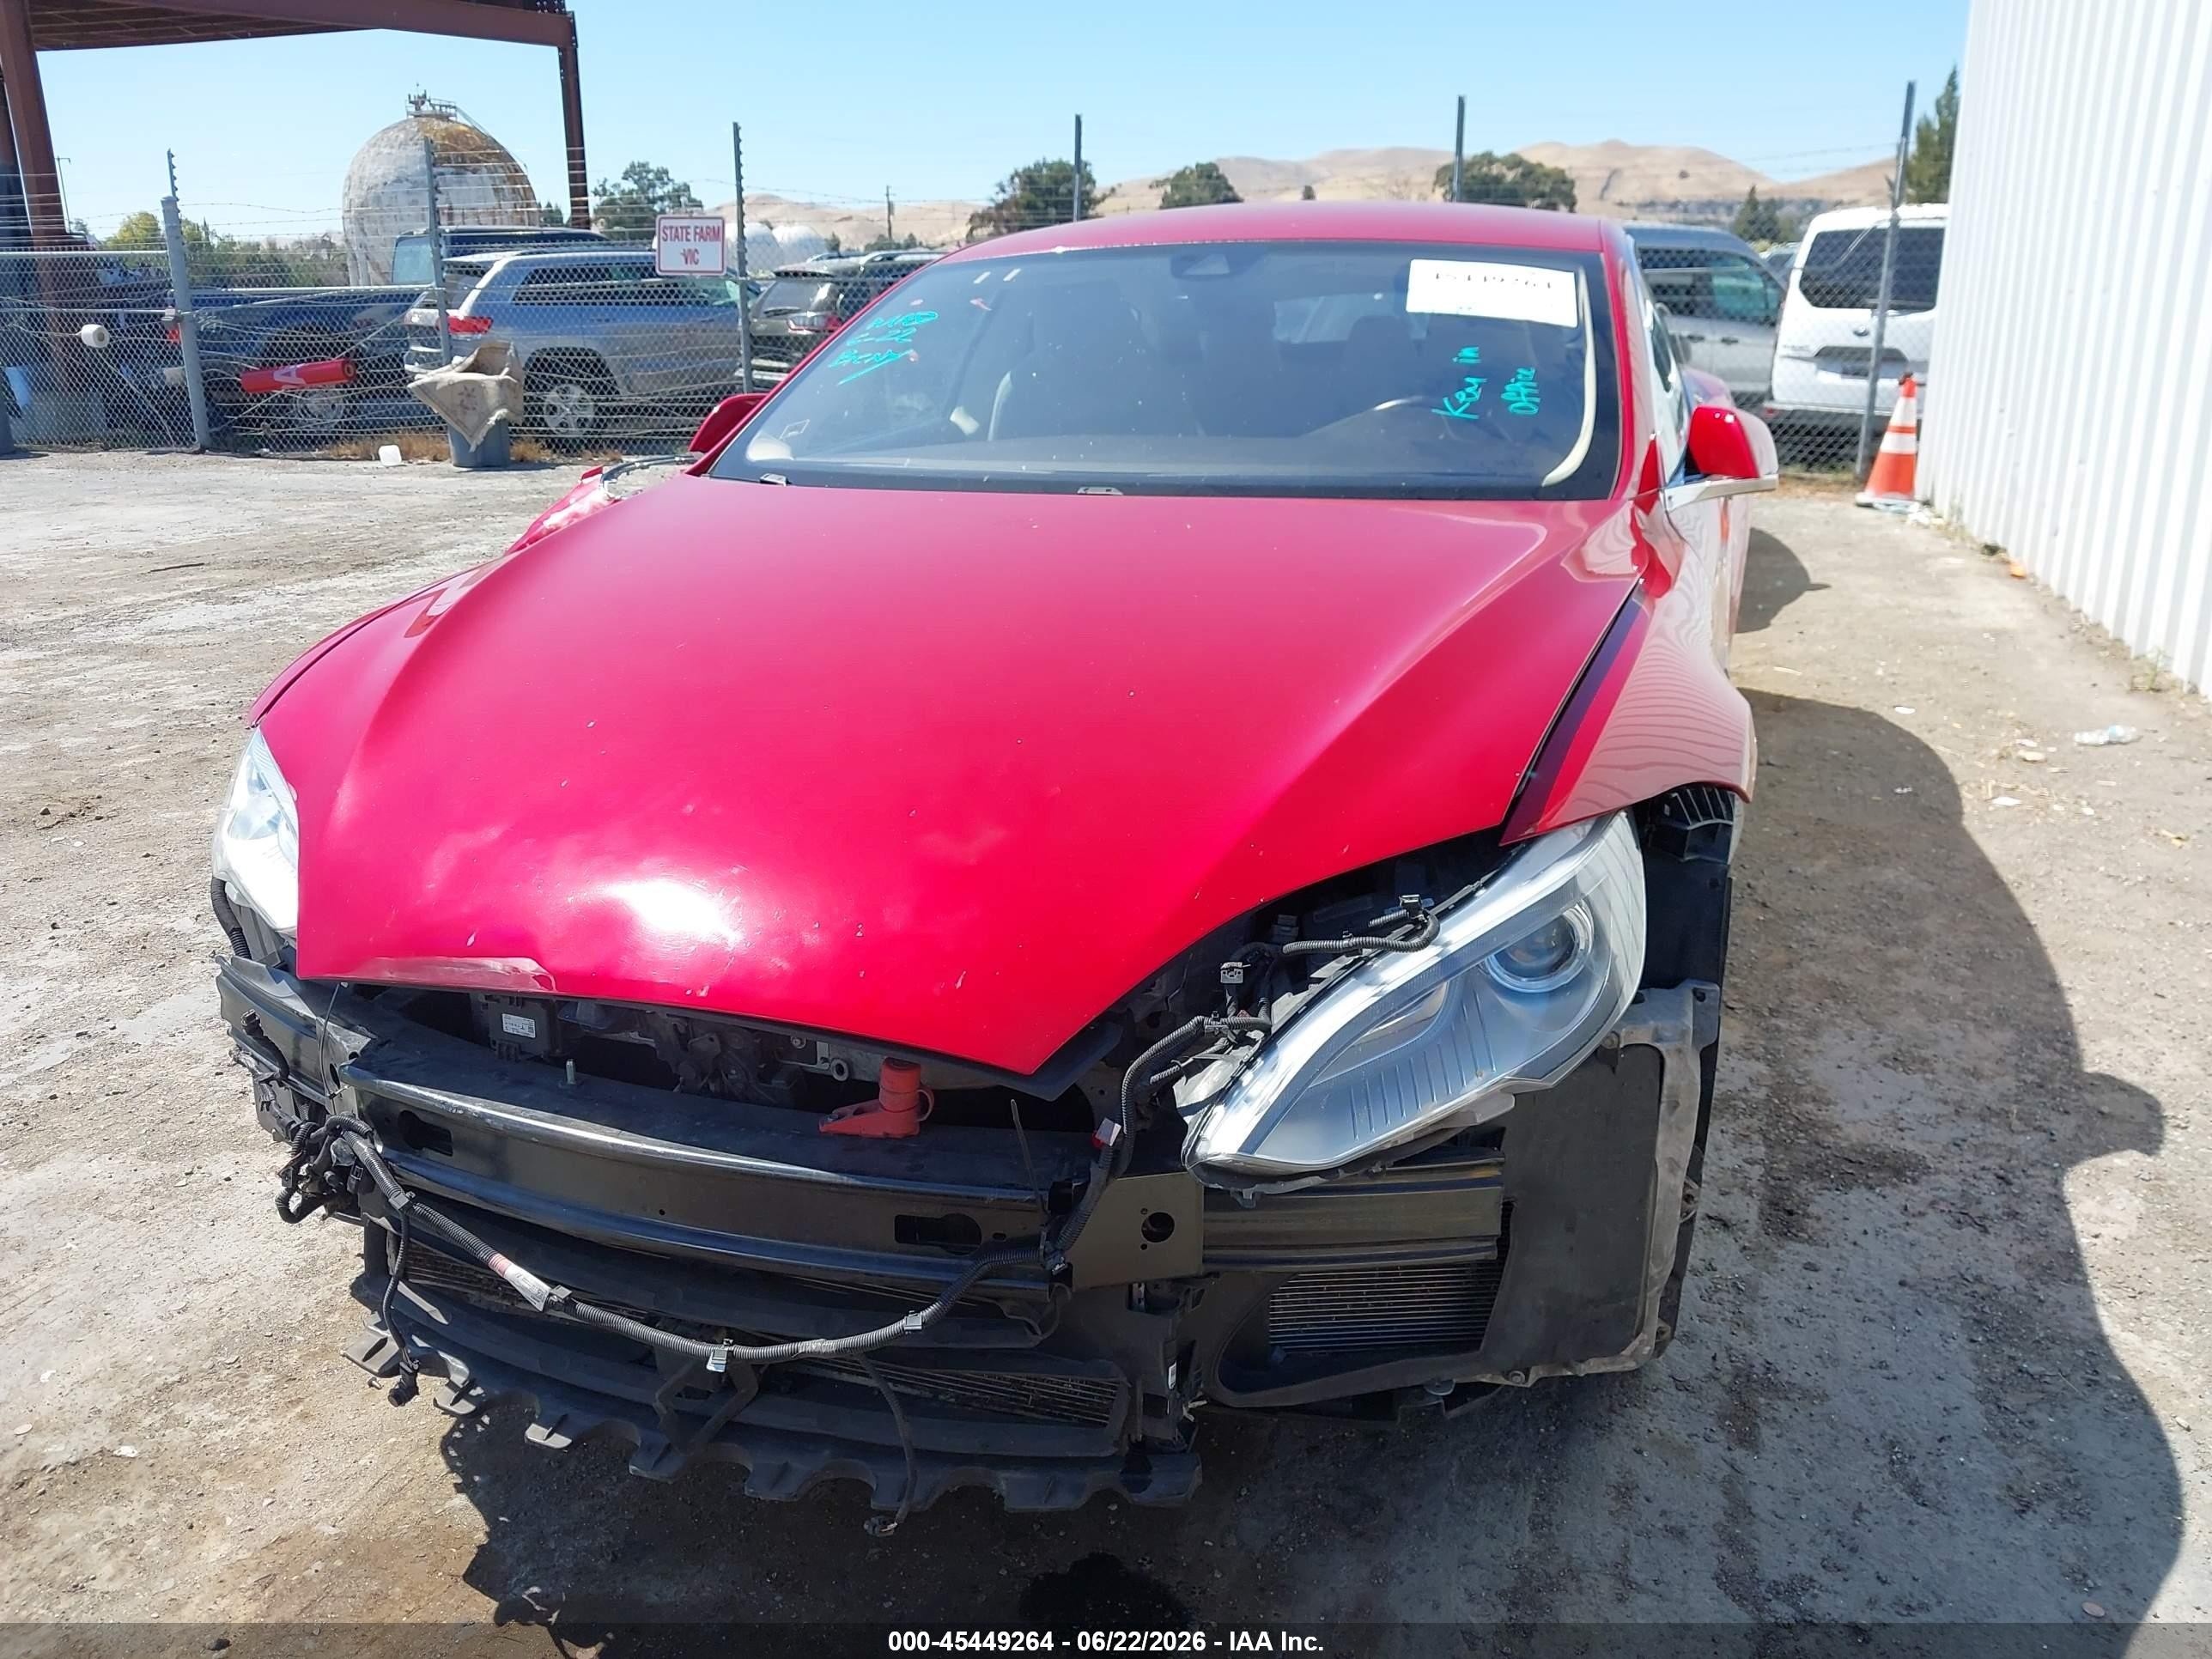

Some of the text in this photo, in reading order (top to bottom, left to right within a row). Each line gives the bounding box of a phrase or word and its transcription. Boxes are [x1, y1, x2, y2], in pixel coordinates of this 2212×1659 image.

[662, 226, 721, 242] STATE FARM
[1431, 346, 1487, 419] Key in
